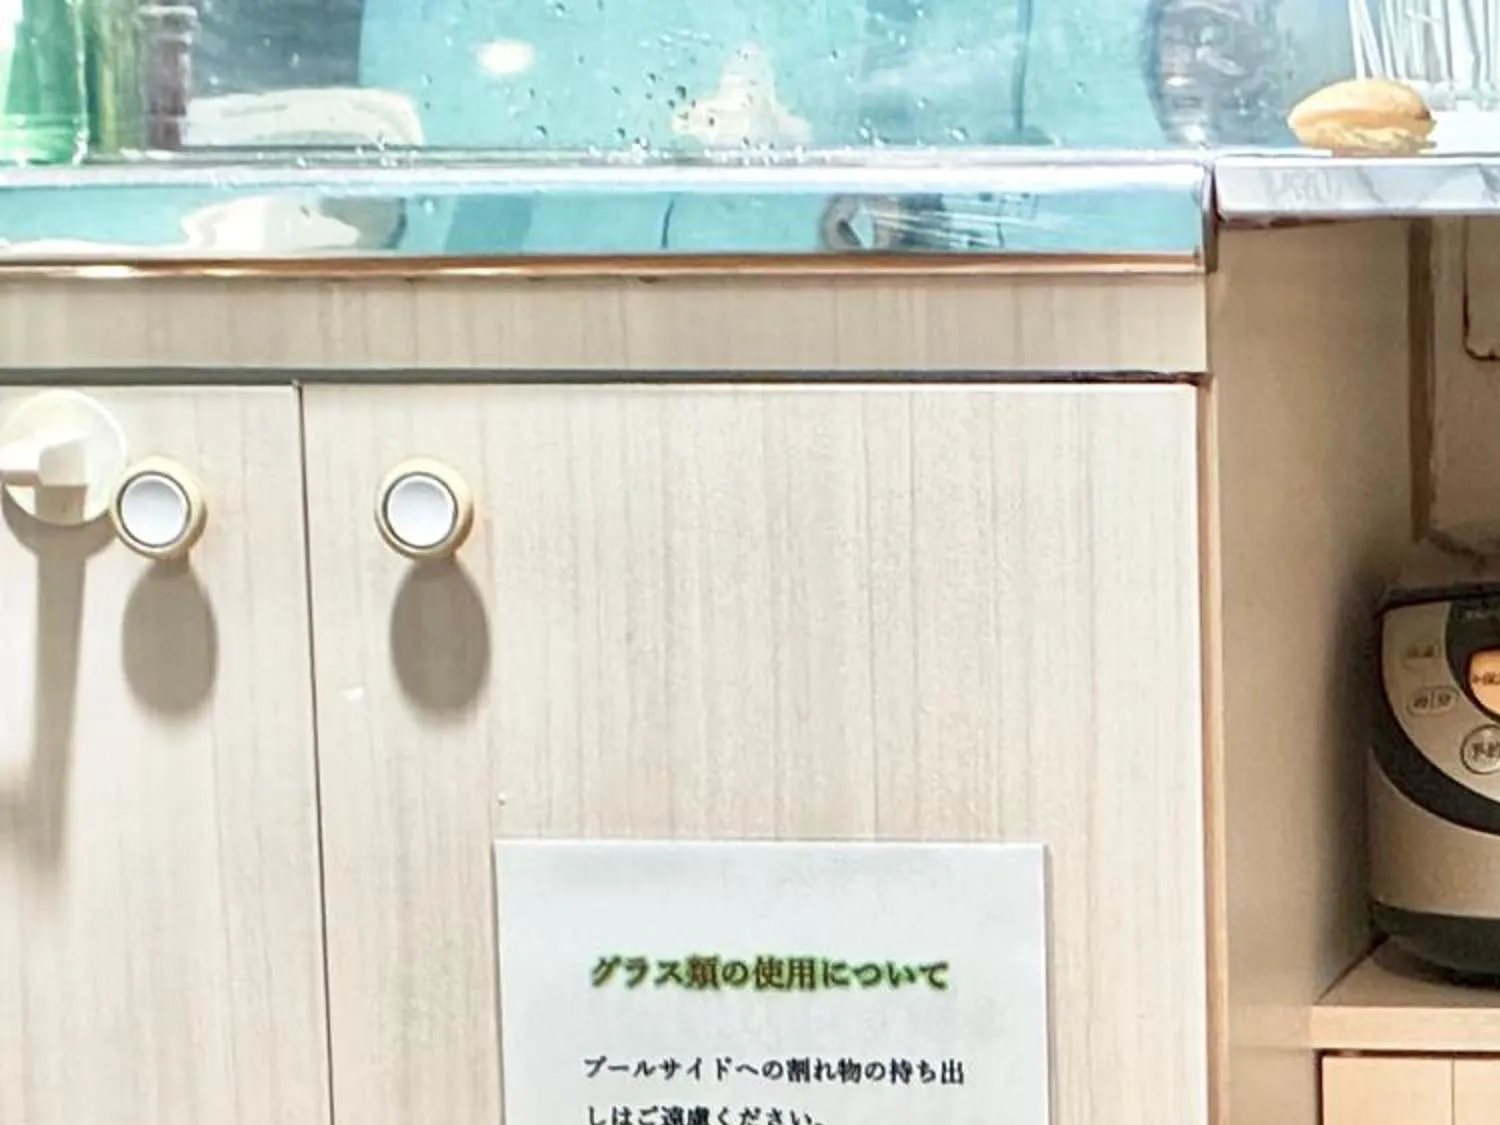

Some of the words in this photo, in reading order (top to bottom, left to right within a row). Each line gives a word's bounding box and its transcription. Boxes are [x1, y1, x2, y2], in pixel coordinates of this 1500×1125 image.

[592, 955, 948, 992] グラス類の使用について
[584, 1056, 964, 1085] プールサイドへの割れ物の持ち出
